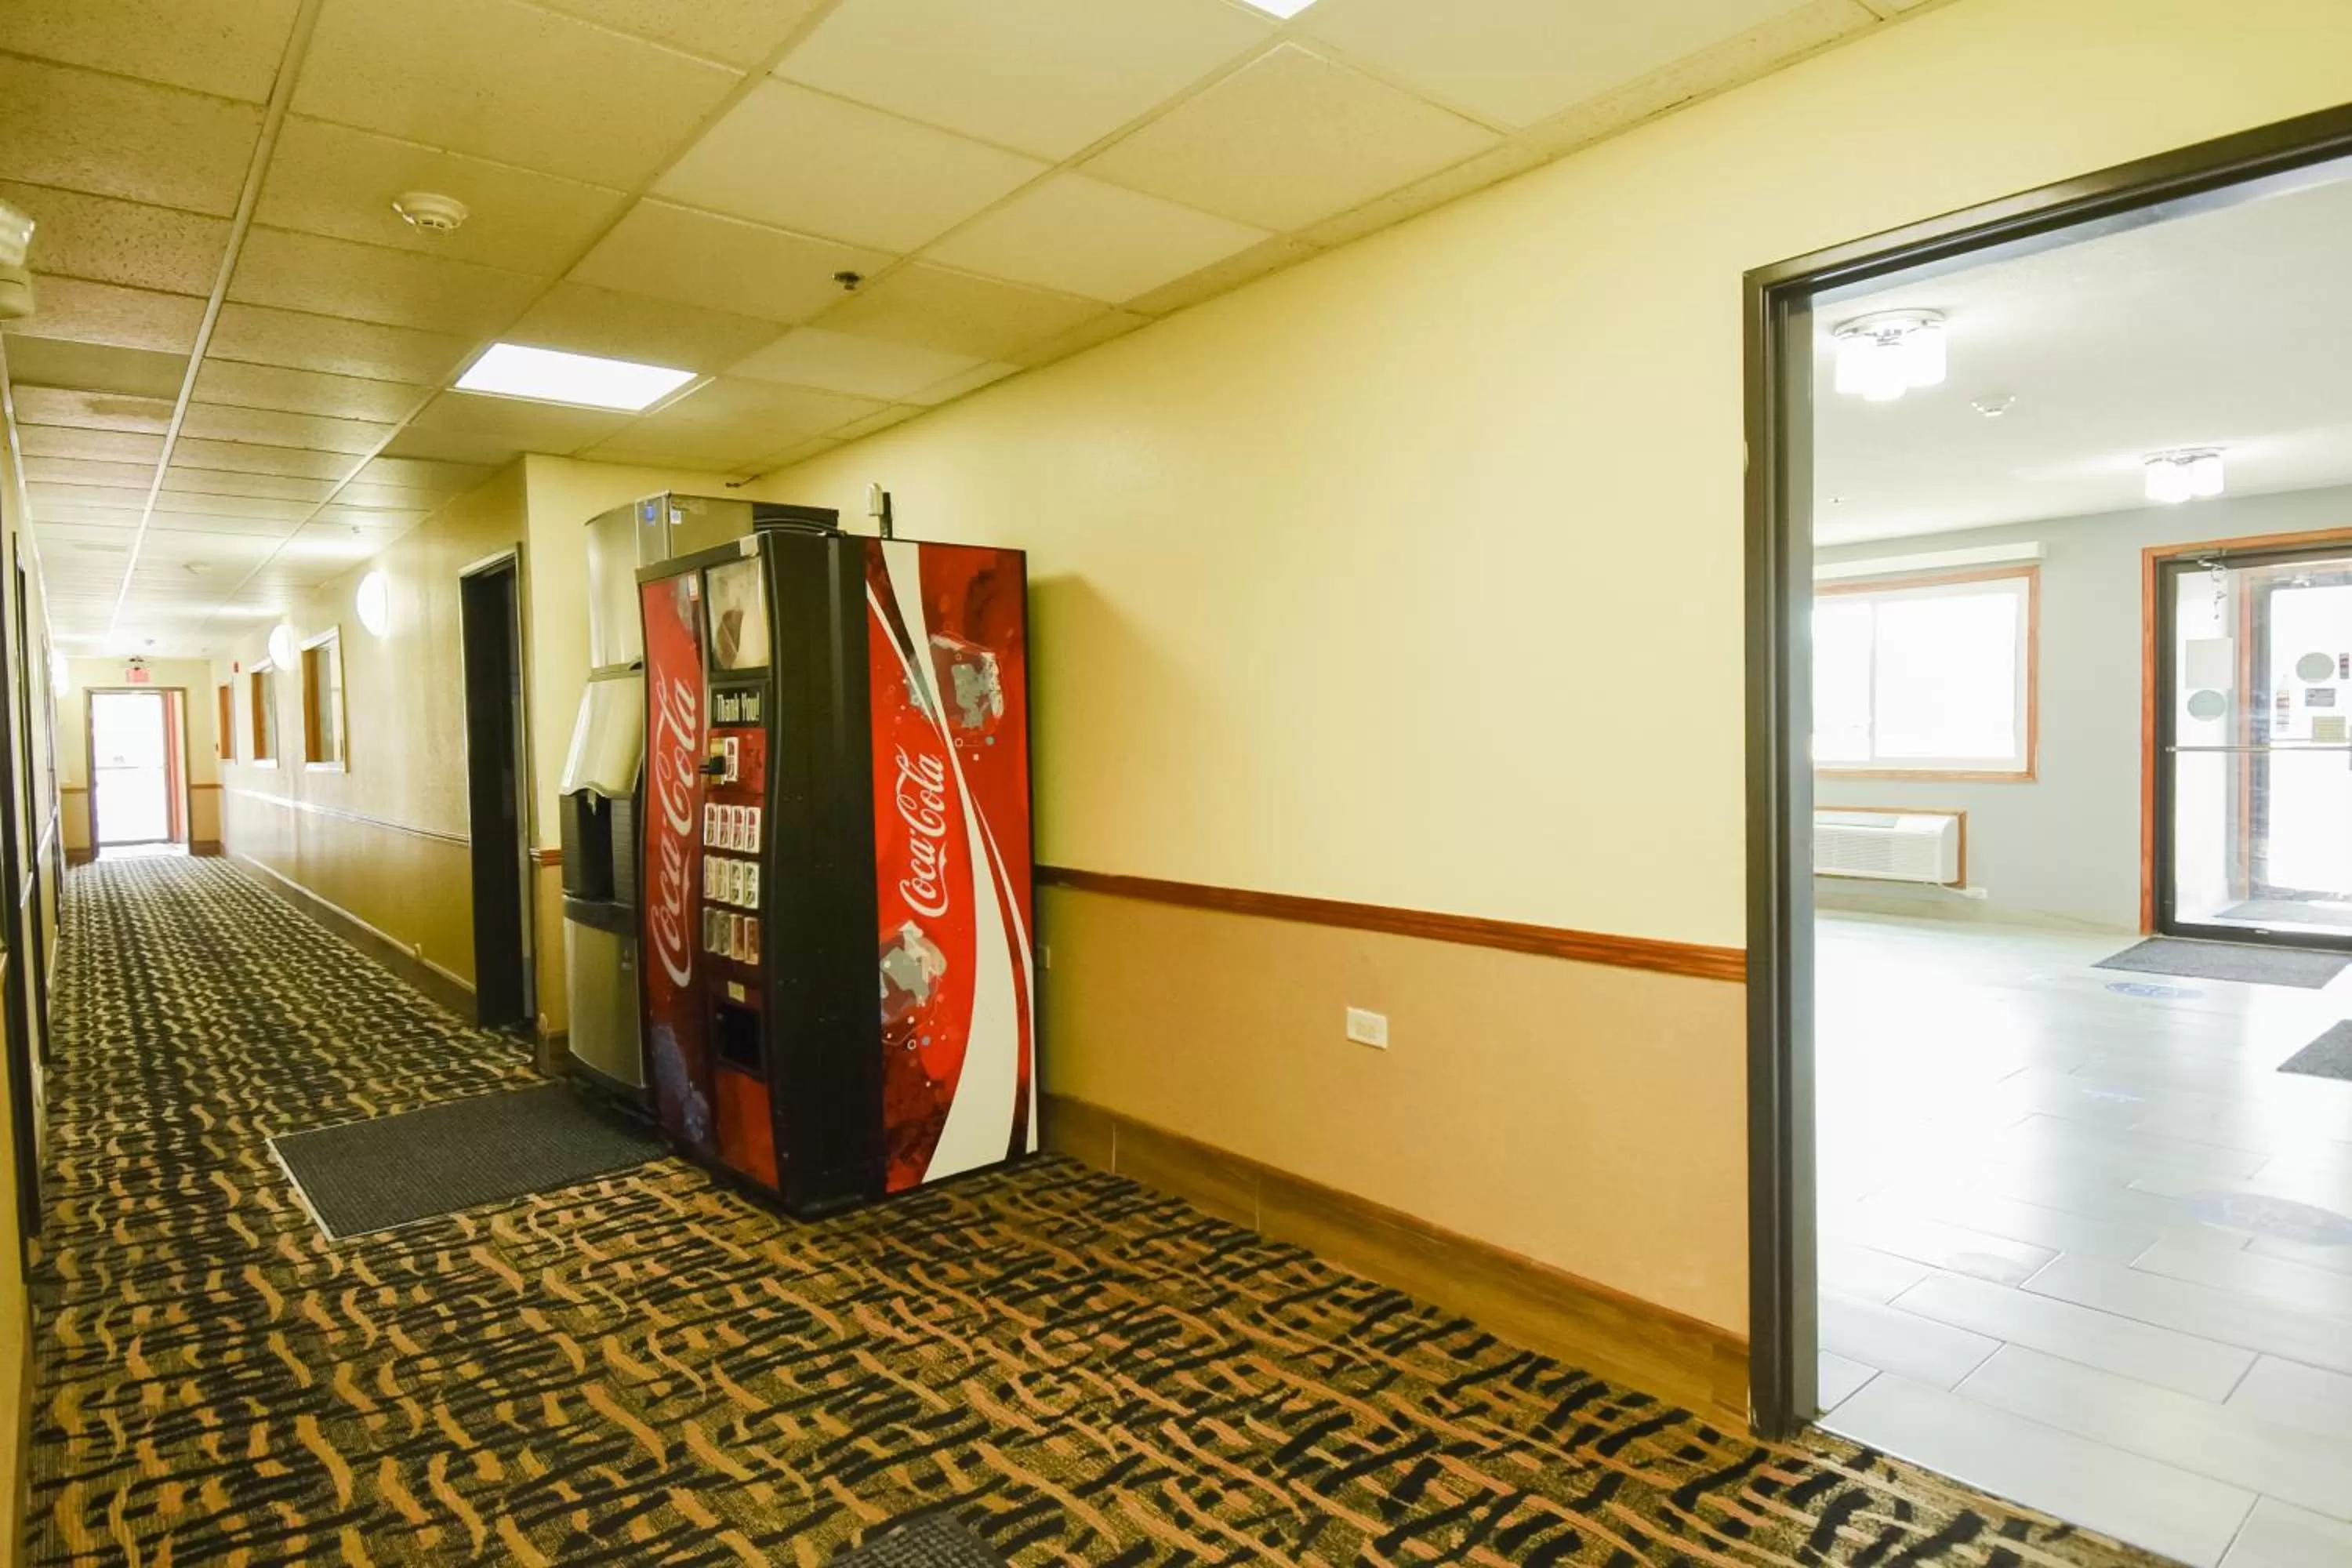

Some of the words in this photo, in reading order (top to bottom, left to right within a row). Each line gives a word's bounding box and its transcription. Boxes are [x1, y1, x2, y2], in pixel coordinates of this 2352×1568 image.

[717, 693, 739, 721] Thank
[741, 691, 760, 721] You!
[650, 664, 697, 988] Coca-Cola
[895, 742, 949, 917] Coca-Cola
